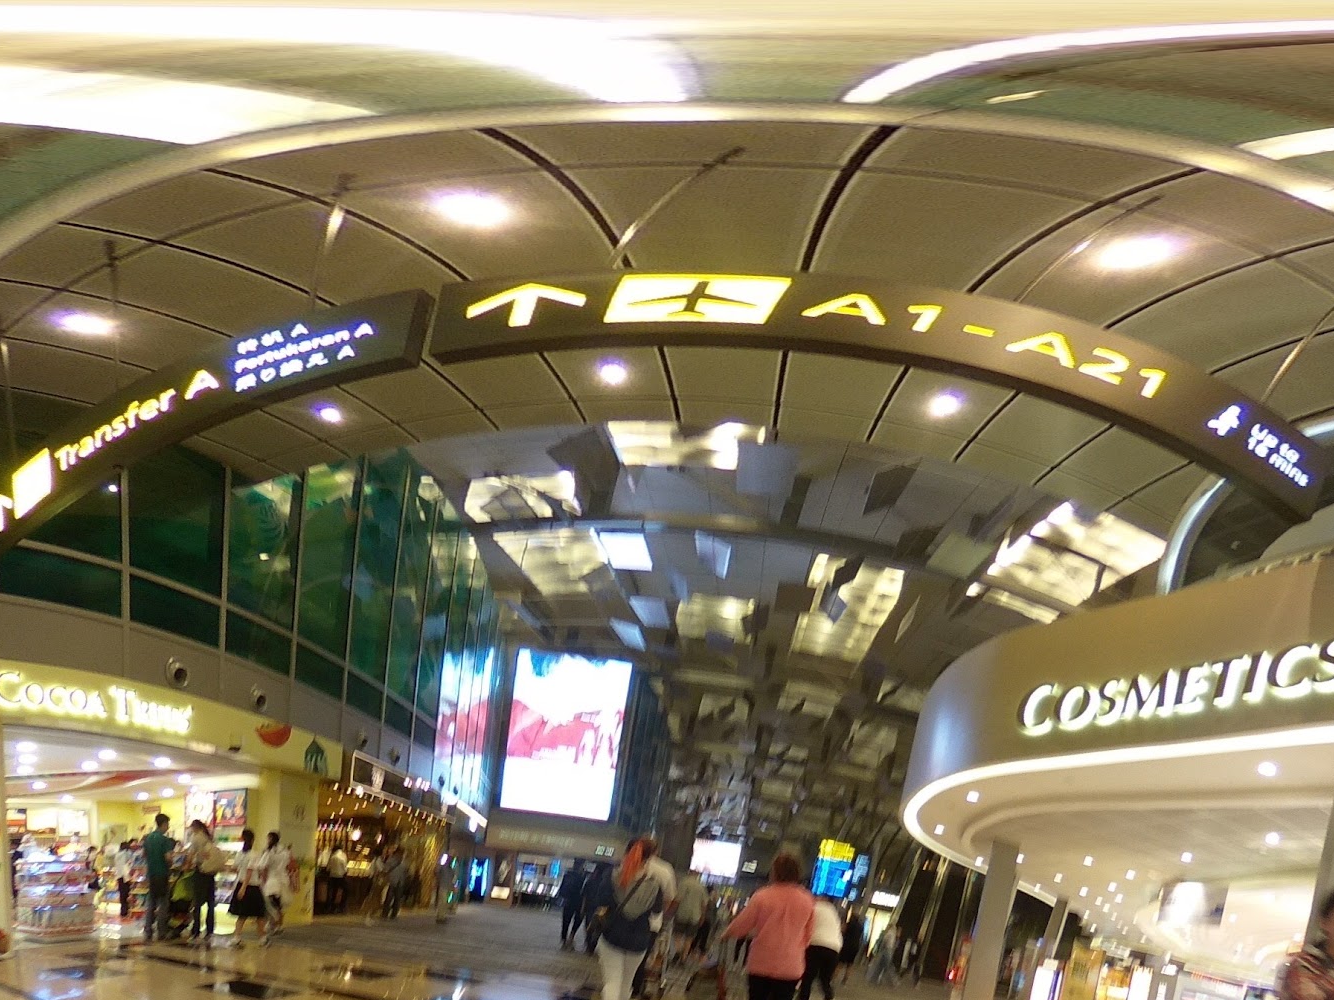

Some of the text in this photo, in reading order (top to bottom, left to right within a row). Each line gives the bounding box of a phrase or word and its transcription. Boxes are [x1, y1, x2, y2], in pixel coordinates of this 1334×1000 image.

[353, 322, 374, 339] A
[54, 368, 220, 472] Transfer A
[1250, 423, 1300, 464] Up to
[1268, 452, 1309, 487] mins
